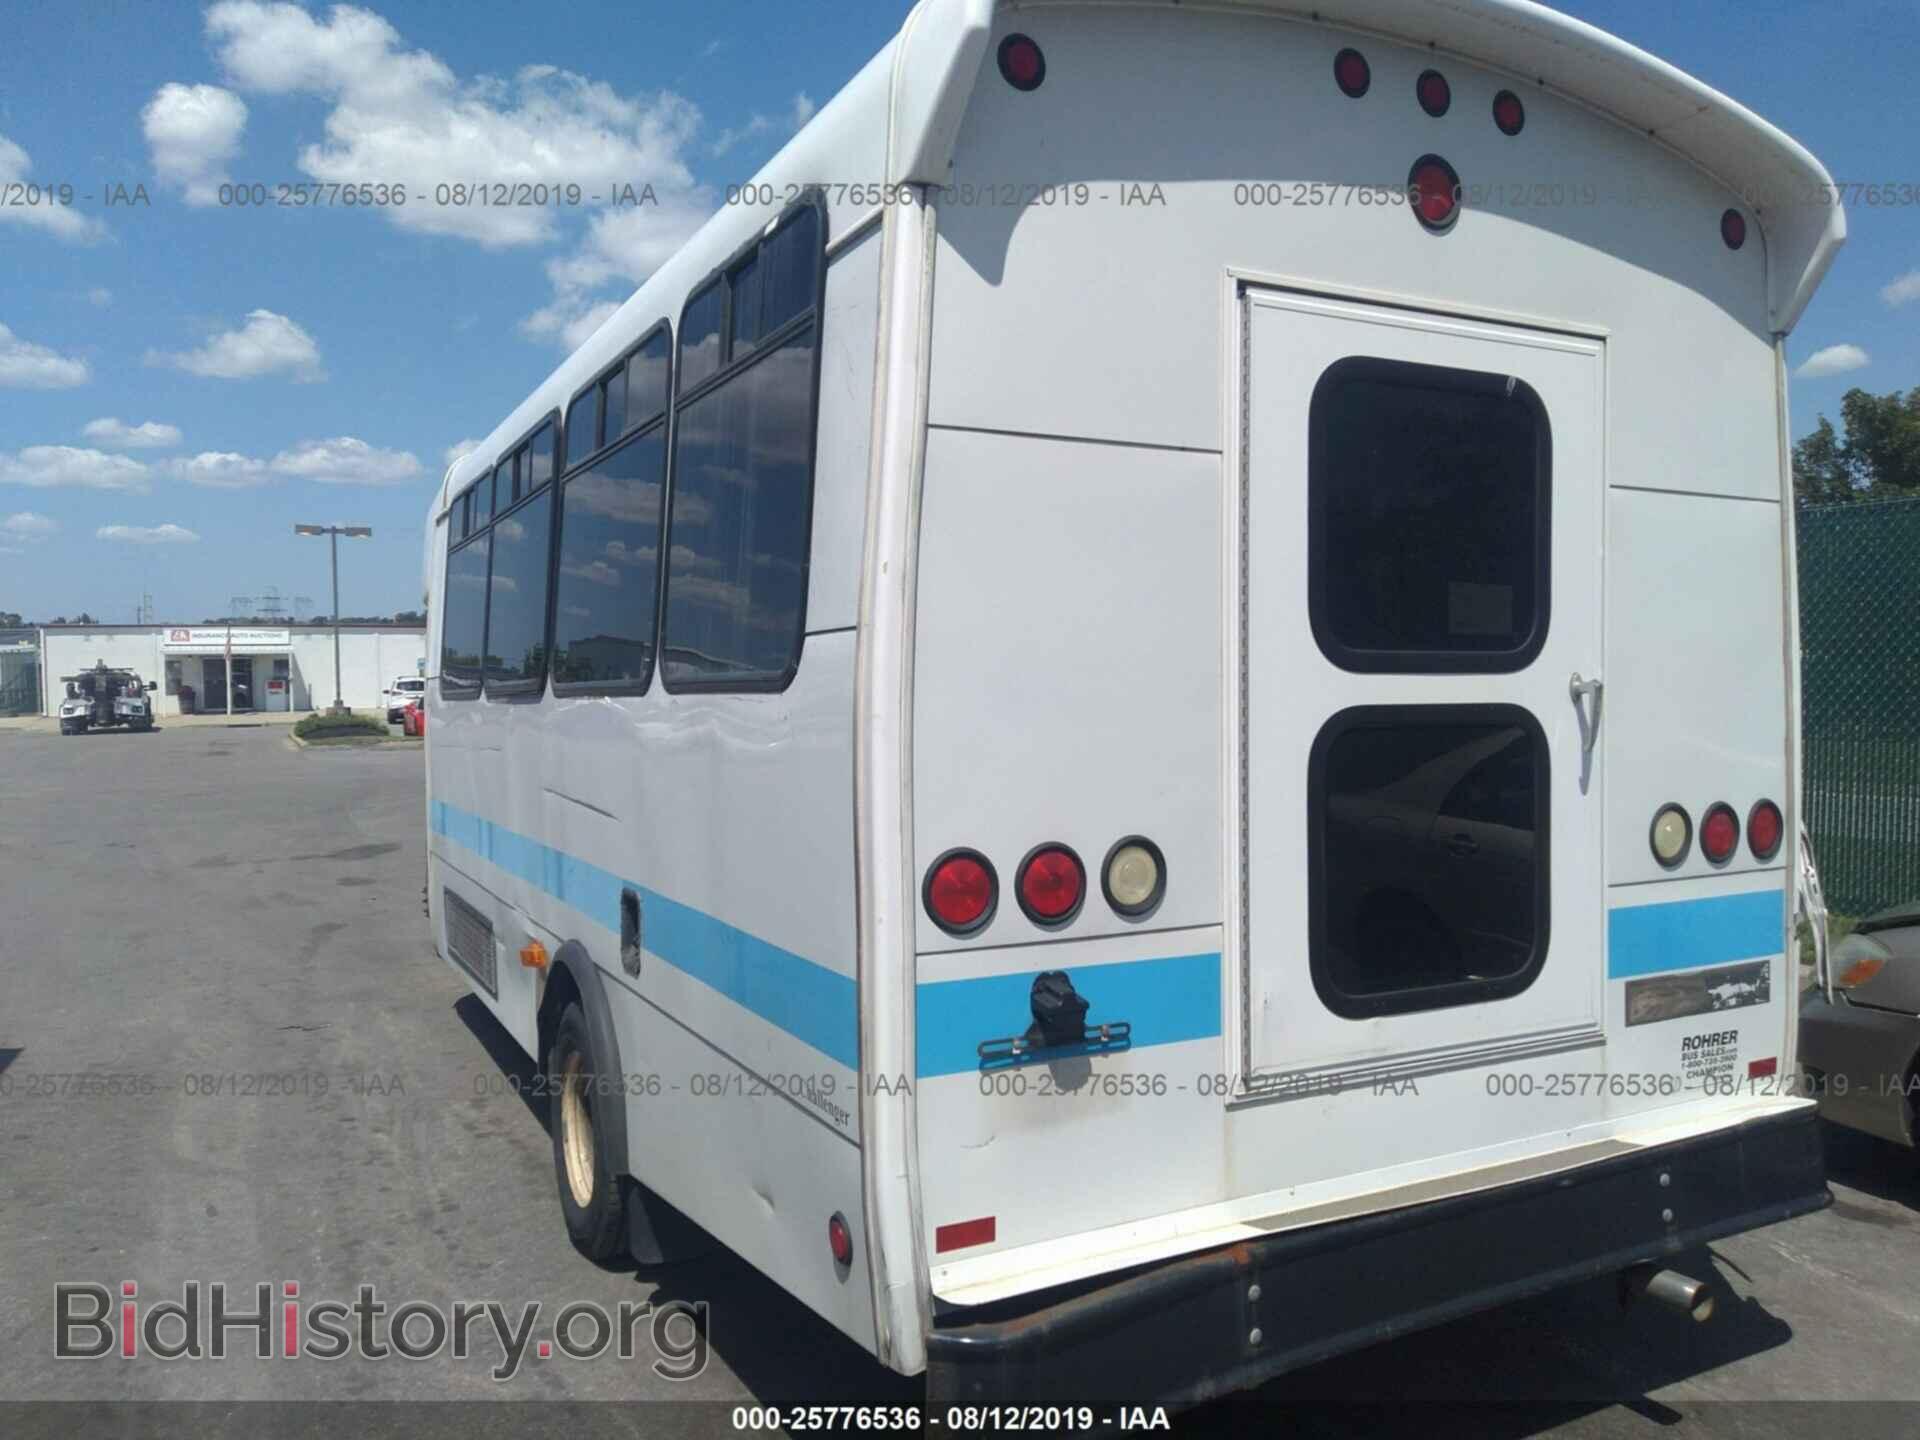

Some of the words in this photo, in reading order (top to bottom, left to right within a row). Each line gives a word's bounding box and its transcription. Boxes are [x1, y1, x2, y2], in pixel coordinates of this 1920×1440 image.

[1681, 1030, 1738, 1051] ROHRER
[1681, 1051, 1698, 1061] BUS
[1686, 1063, 1734, 1079] CHAMPION
